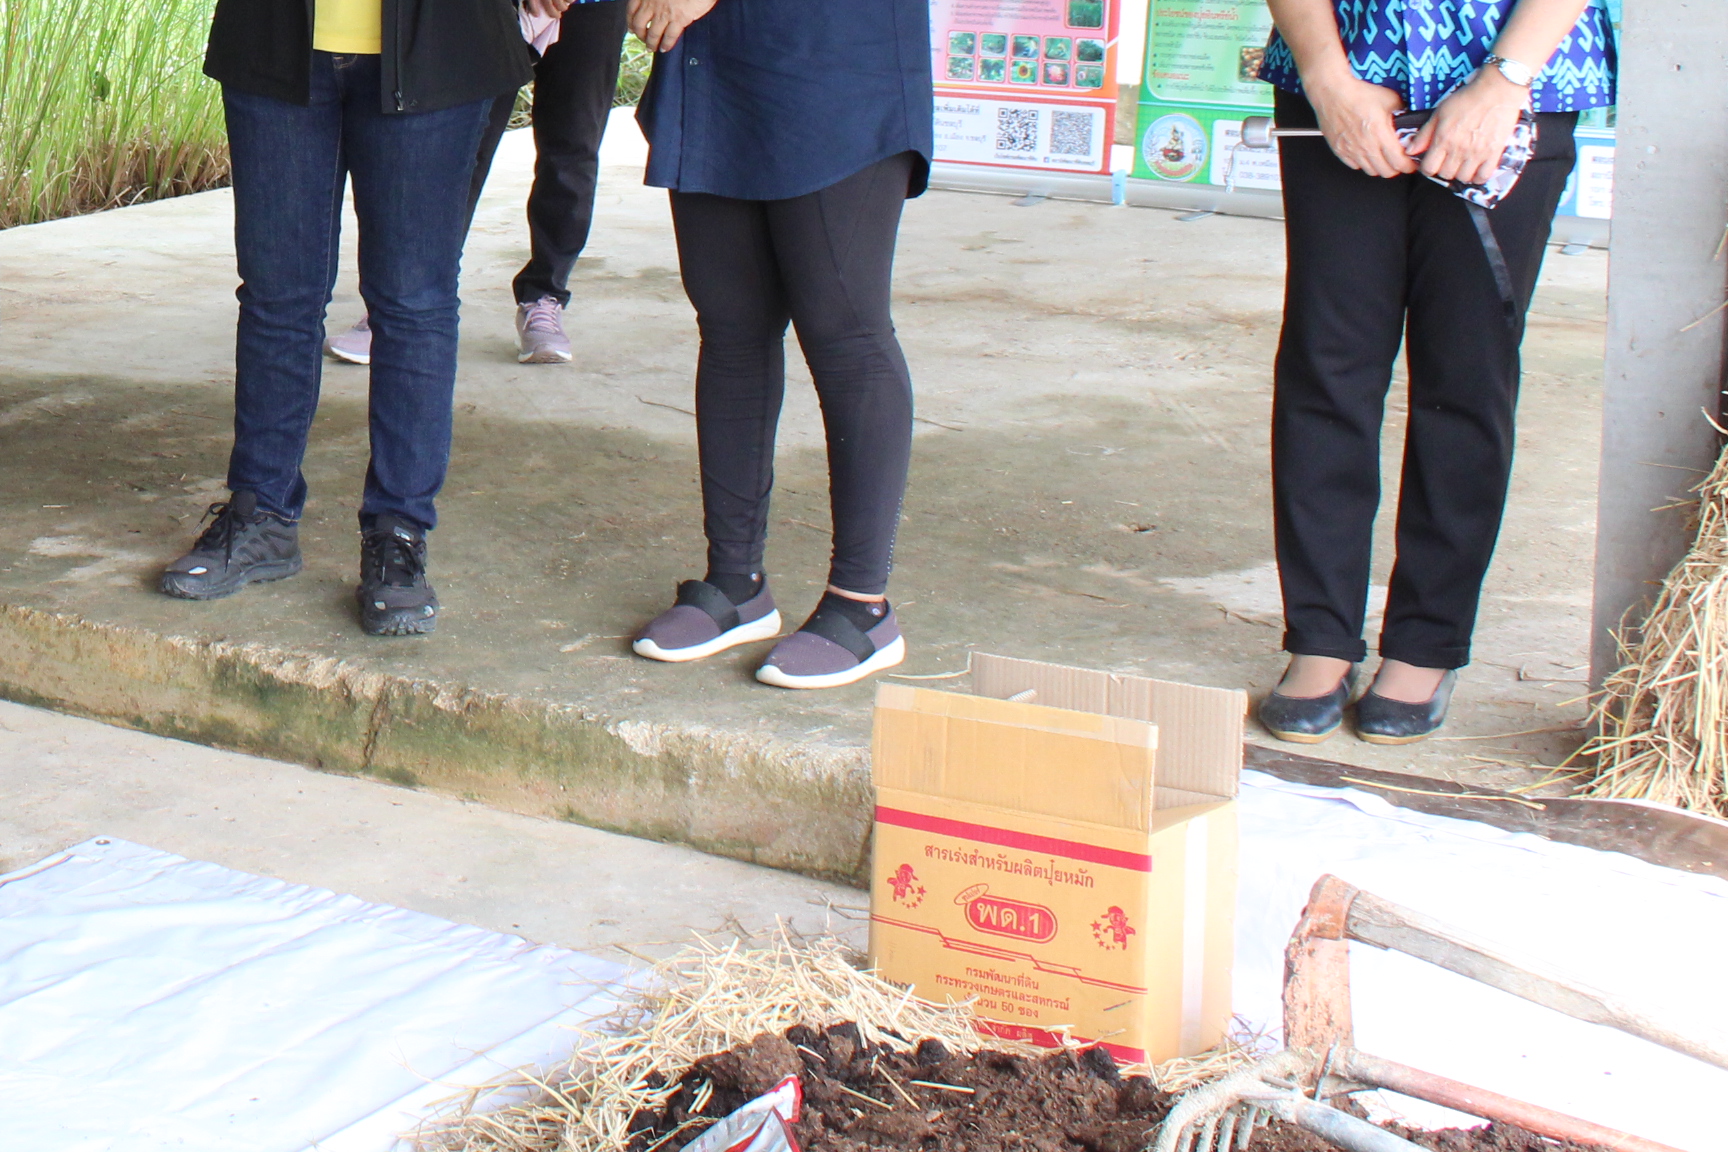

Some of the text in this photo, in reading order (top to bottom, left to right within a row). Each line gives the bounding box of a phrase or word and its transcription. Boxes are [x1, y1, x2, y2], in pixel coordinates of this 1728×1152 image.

[925, 844, 1094, 888] สารเร่งสำหรับผลิตปุ๋ยหมัก
[977, 902, 1041, 934] พด.1
[935, 974, 1070, 1011] กระทรวงเกษตรและสหกรณ์
[965, 965, 1039, 990] กรมพัฒนาที่ดิน
[1001, 1001, 1014, 1013] 50
[1018, 1006, 1039, 1019] ซอง
